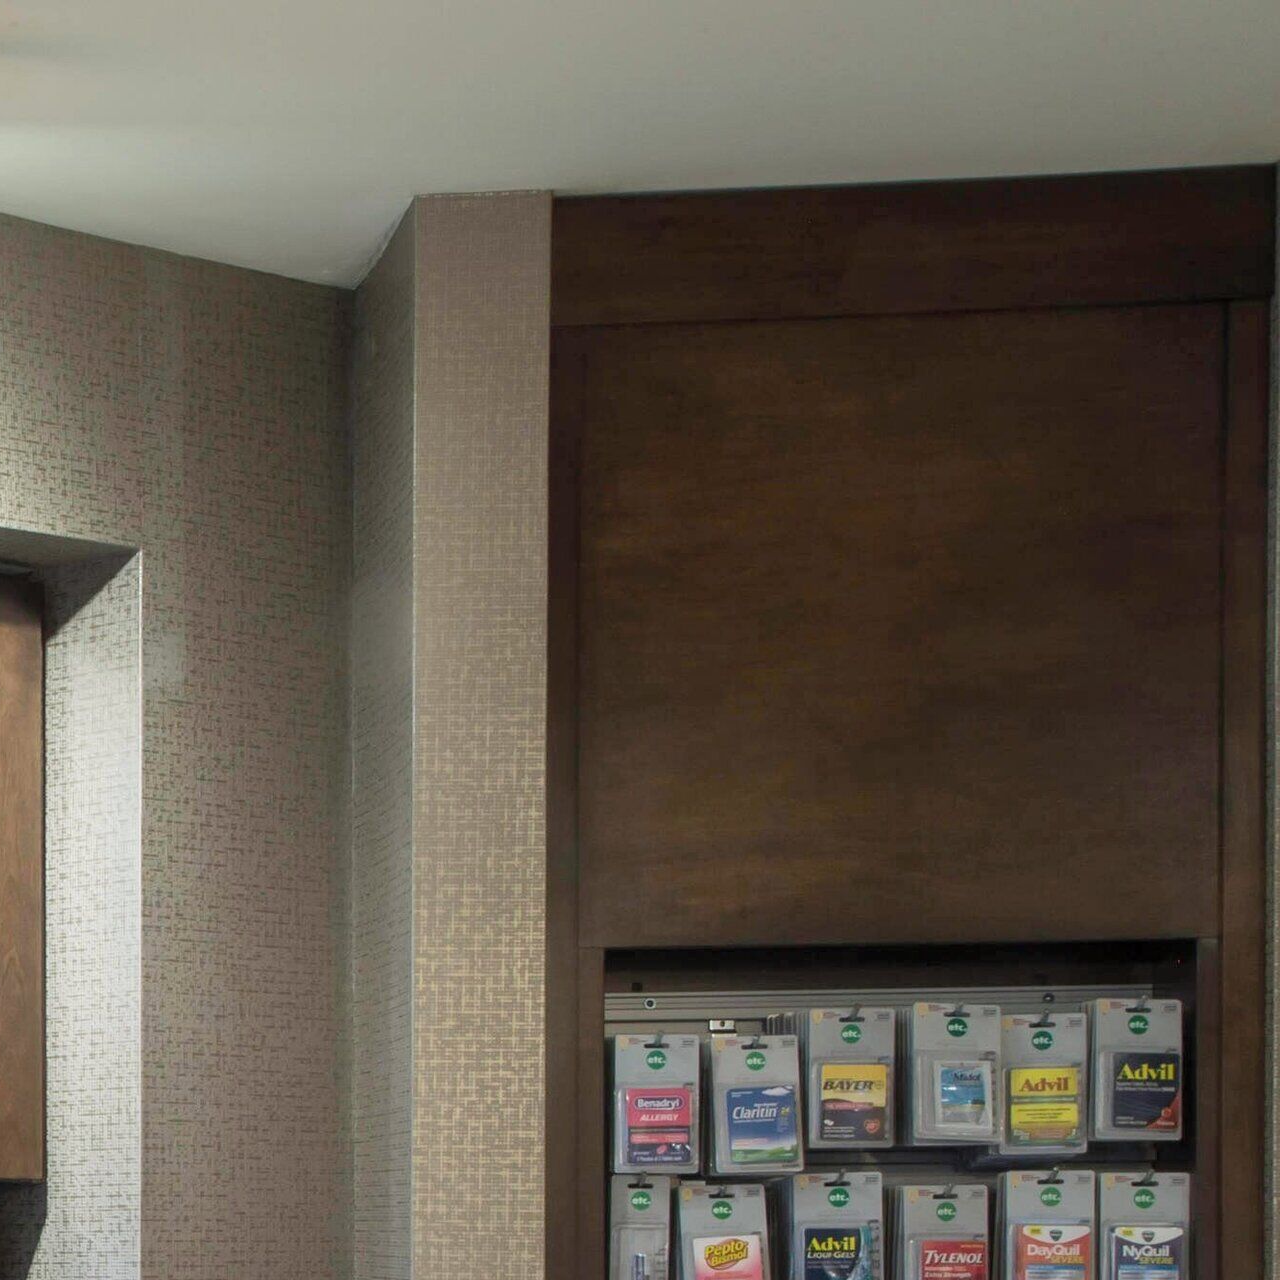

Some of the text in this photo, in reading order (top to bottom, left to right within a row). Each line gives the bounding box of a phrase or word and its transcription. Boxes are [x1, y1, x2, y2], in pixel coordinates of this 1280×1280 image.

[1116, 1062, 1177, 1081] Advil
[822, 1079, 875, 1092] BAYER
[1018, 1076, 1070, 1093] Advil
[637, 1097, 681, 1111] Benadryl
[640, 1113, 679, 1122] ALLERGY
[732, 1106, 778, 1120] Claritin
[807, 1236, 857, 1252] Advil
[1027, 1244, 1081, 1260] DayQuil
[710, 1250, 749, 1267] Bismol
[924, 1249, 984, 1264] TYLENOL
[1122, 1244, 1170, 1261] NyQuil
